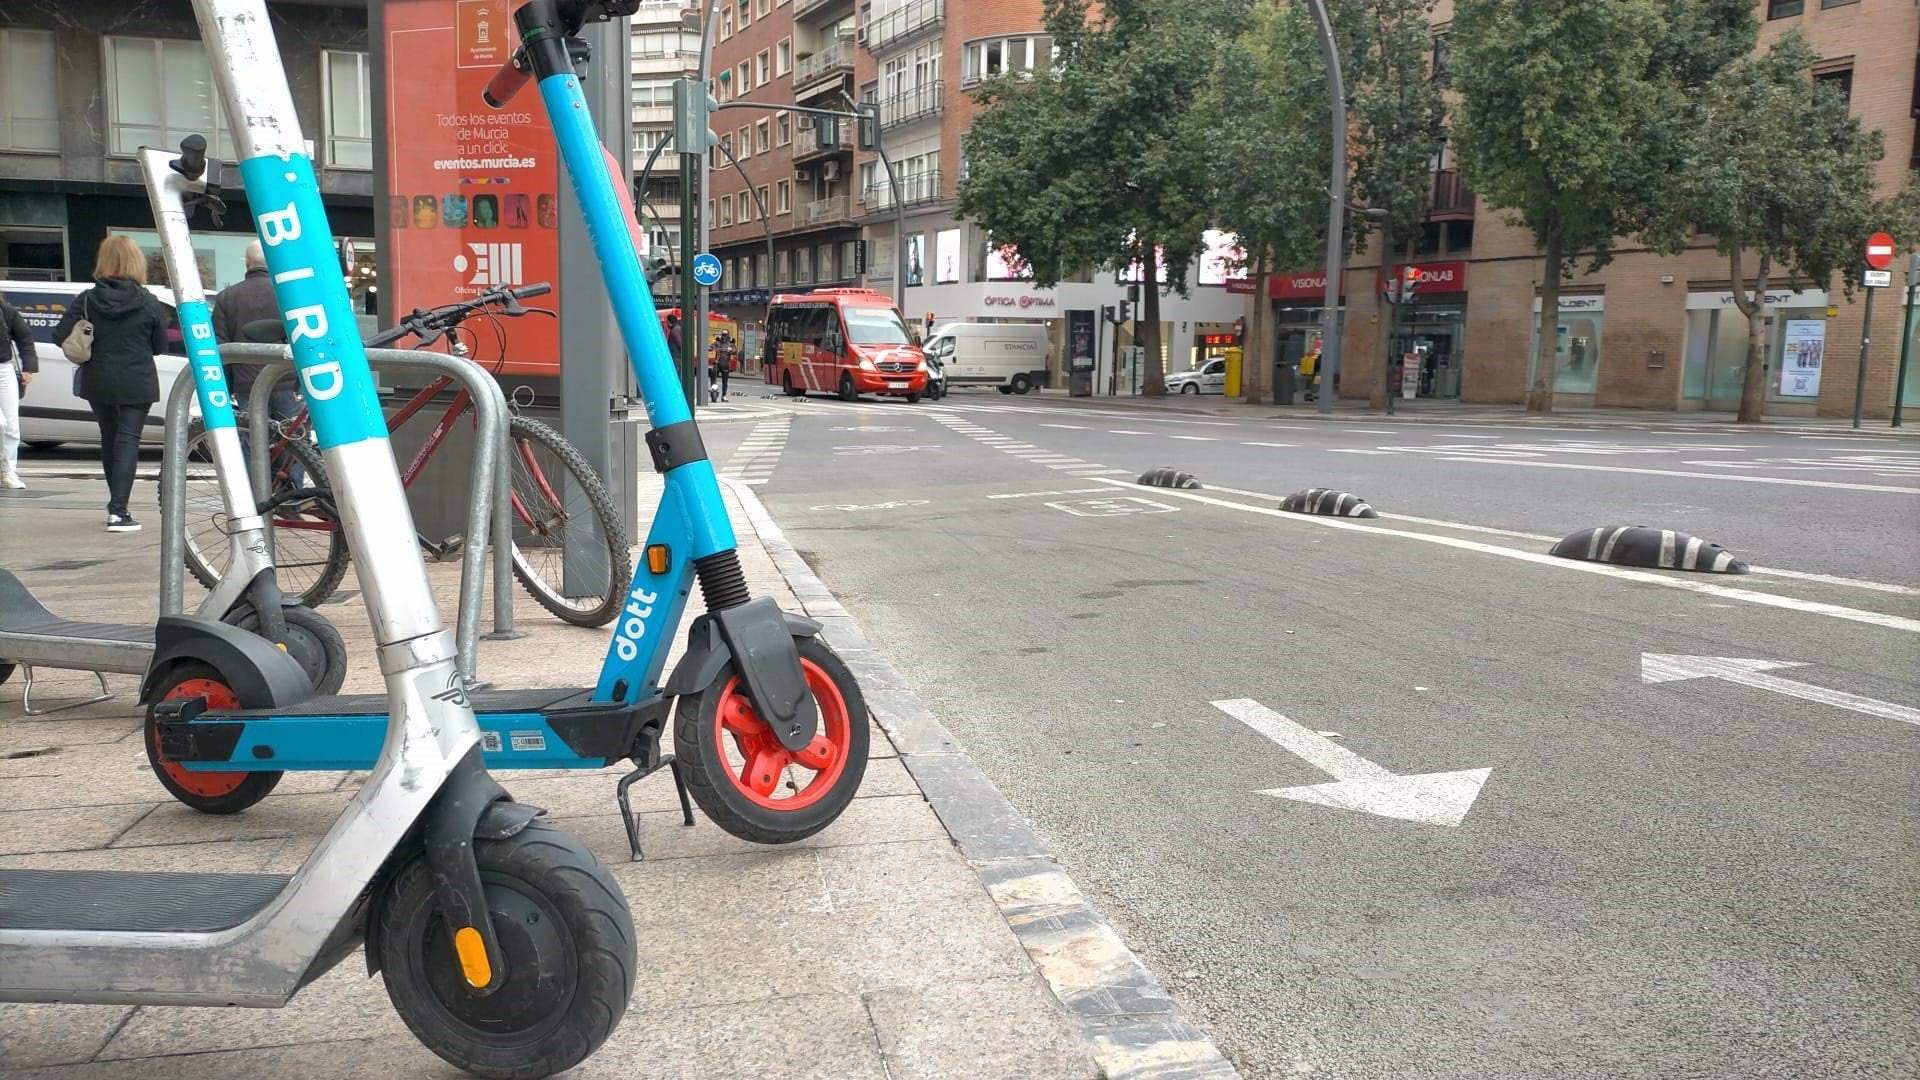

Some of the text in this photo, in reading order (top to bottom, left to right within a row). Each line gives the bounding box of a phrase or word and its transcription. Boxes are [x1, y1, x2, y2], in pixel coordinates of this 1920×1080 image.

[436, 111, 531, 126] Todos los eventos
[457, 126, 509, 140] de Murcia
[458, 144, 464, 154] a
[467, 144, 481, 154] un
[433, 153, 536, 170] eventos.murcia.es
[347, 249, 353, 263] 30
[454, 286, 477, 294] Oficina
[1292, 278, 1328, 289] VISIONLA
[257, 201, 344, 402] BIRD
[191, 322, 227, 408] BIRD
[615, 588, 658, 661] dott
